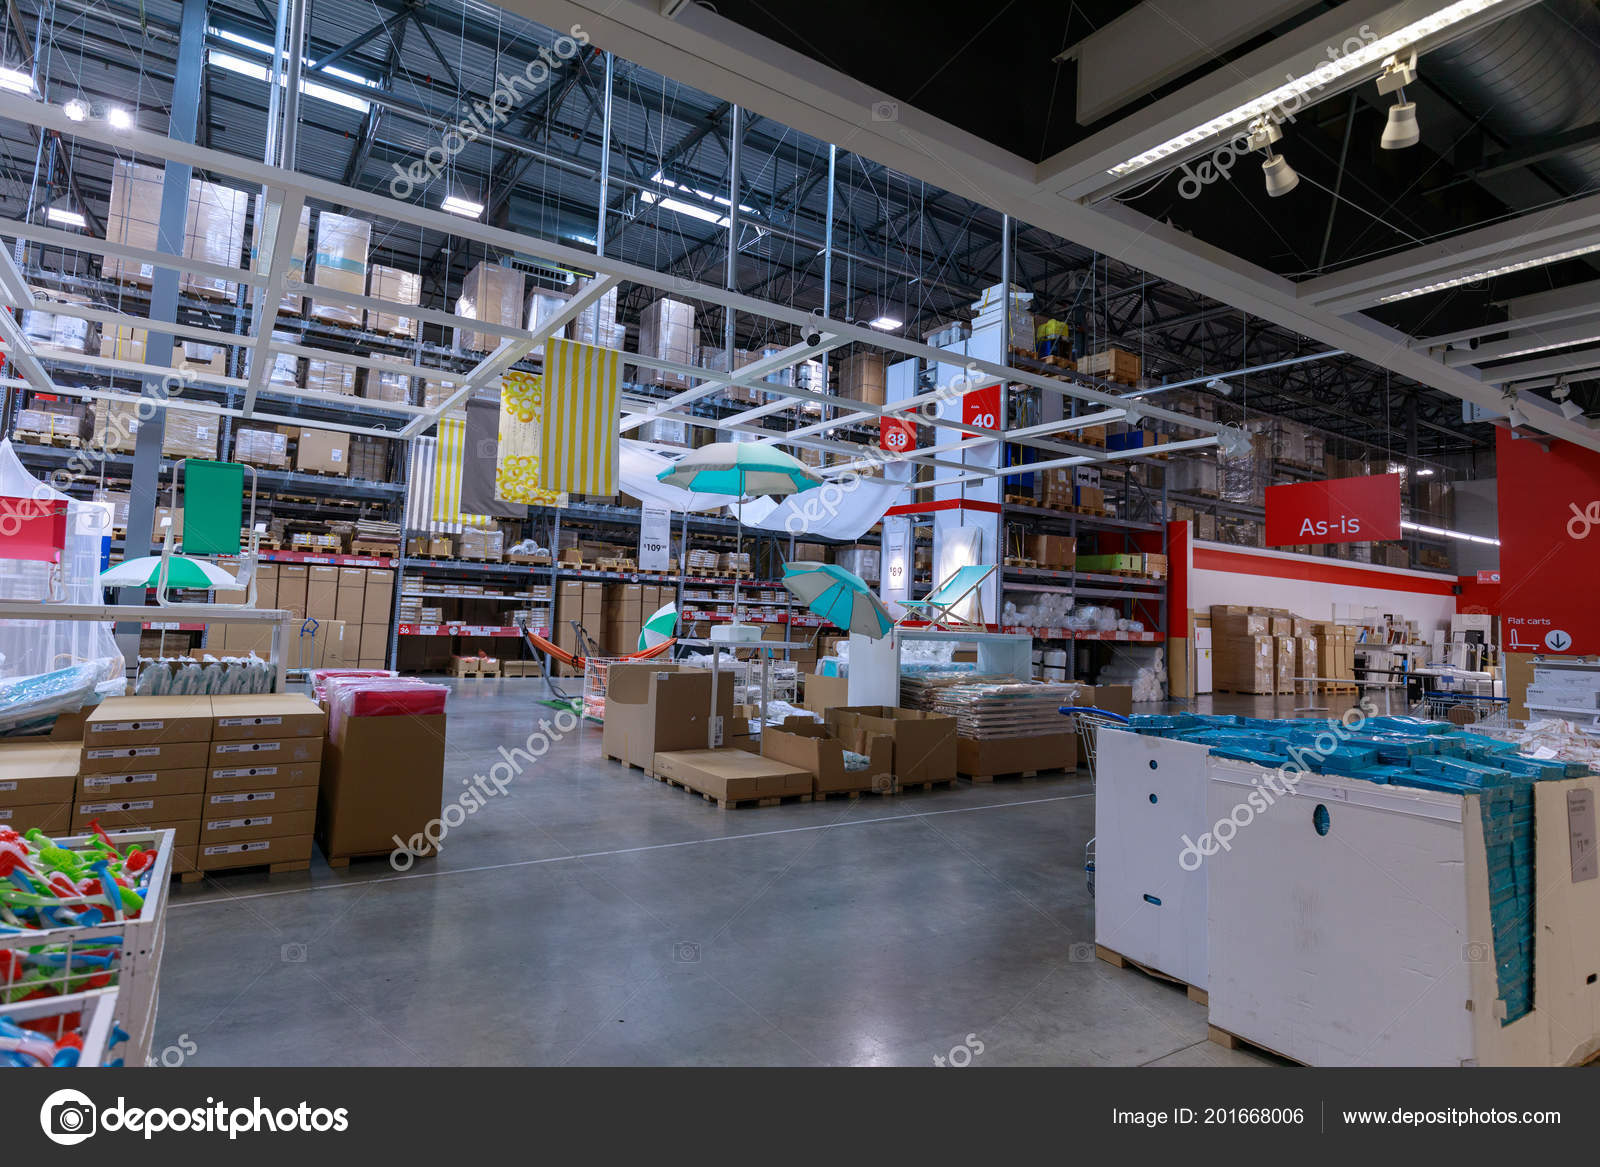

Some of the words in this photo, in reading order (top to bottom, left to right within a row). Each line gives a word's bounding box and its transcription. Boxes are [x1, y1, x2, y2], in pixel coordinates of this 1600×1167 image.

[971, 413, 995, 428] 40
[887, 433, 906, 446] 38
[1299, 515, 1361, 536] As-is
[1508, 616, 1525, 625] Flat
[1527, 617, 1551, 625] carts
